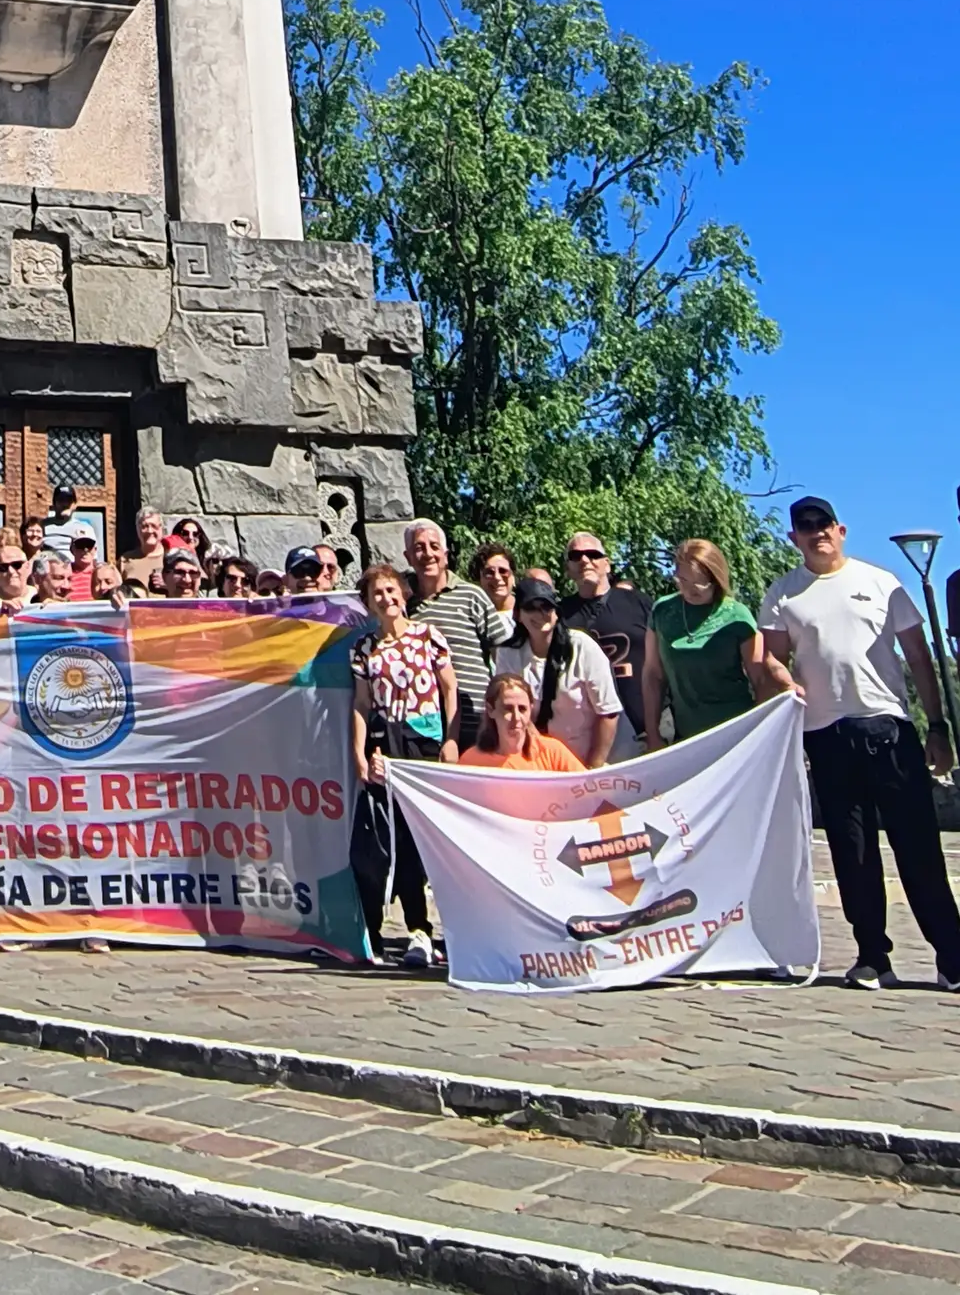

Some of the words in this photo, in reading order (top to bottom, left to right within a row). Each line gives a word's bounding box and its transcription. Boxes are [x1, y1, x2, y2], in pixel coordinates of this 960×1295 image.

[28, 775, 88, 813] DE
[101, 772, 344, 820] RETIRADOS
[577, 834, 651, 861] RANDOM
[43, 875, 90, 906] DE
[101, 873, 220, 906] ENTRE
[231, 867, 312, 915] RÍOS
[619, 923, 701, 965] ENTRE
